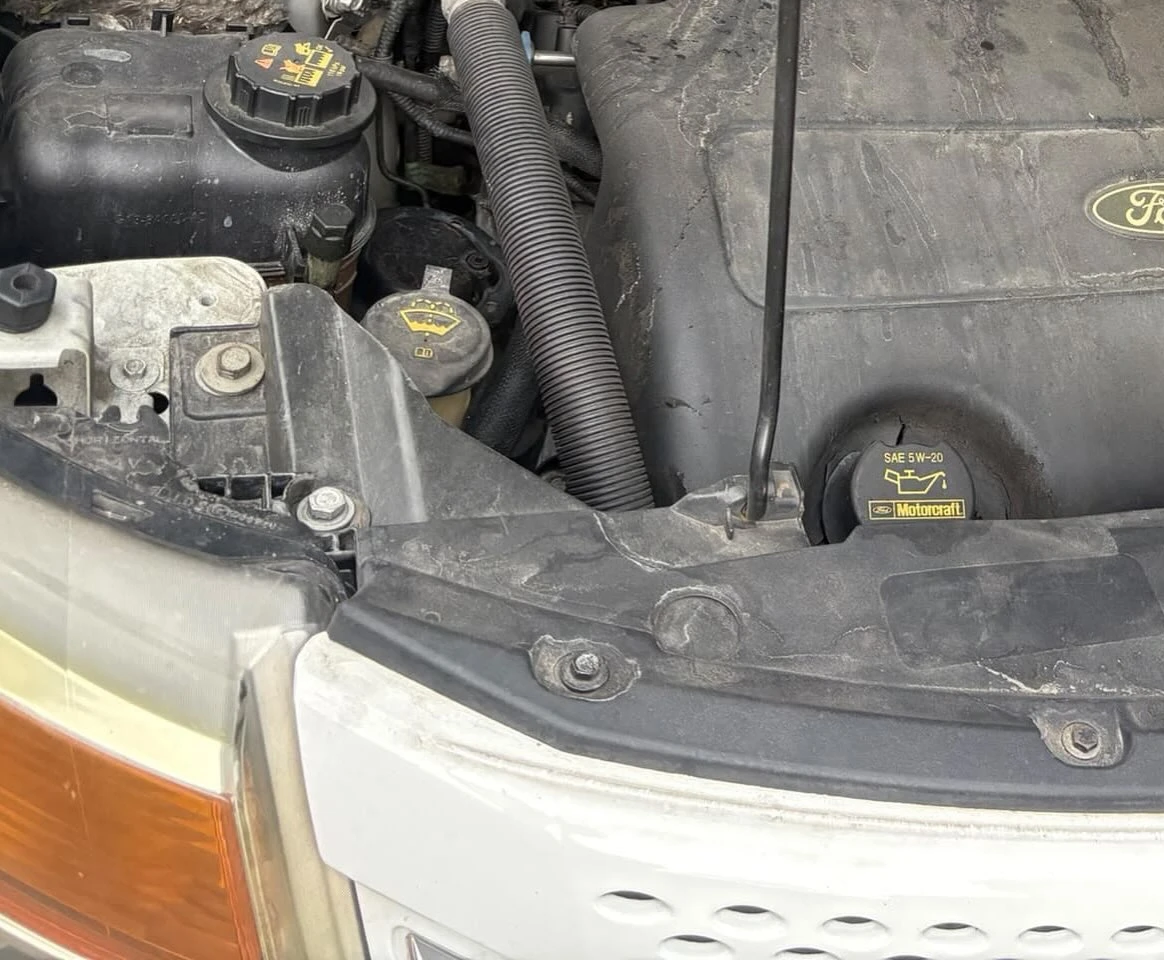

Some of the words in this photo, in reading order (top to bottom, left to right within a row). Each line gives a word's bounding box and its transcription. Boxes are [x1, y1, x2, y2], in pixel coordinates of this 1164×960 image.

[884, 452, 905, 464] SAE
[908, 452, 944, 463] 5W-20
[896, 502, 961, 517] Motorcraft
